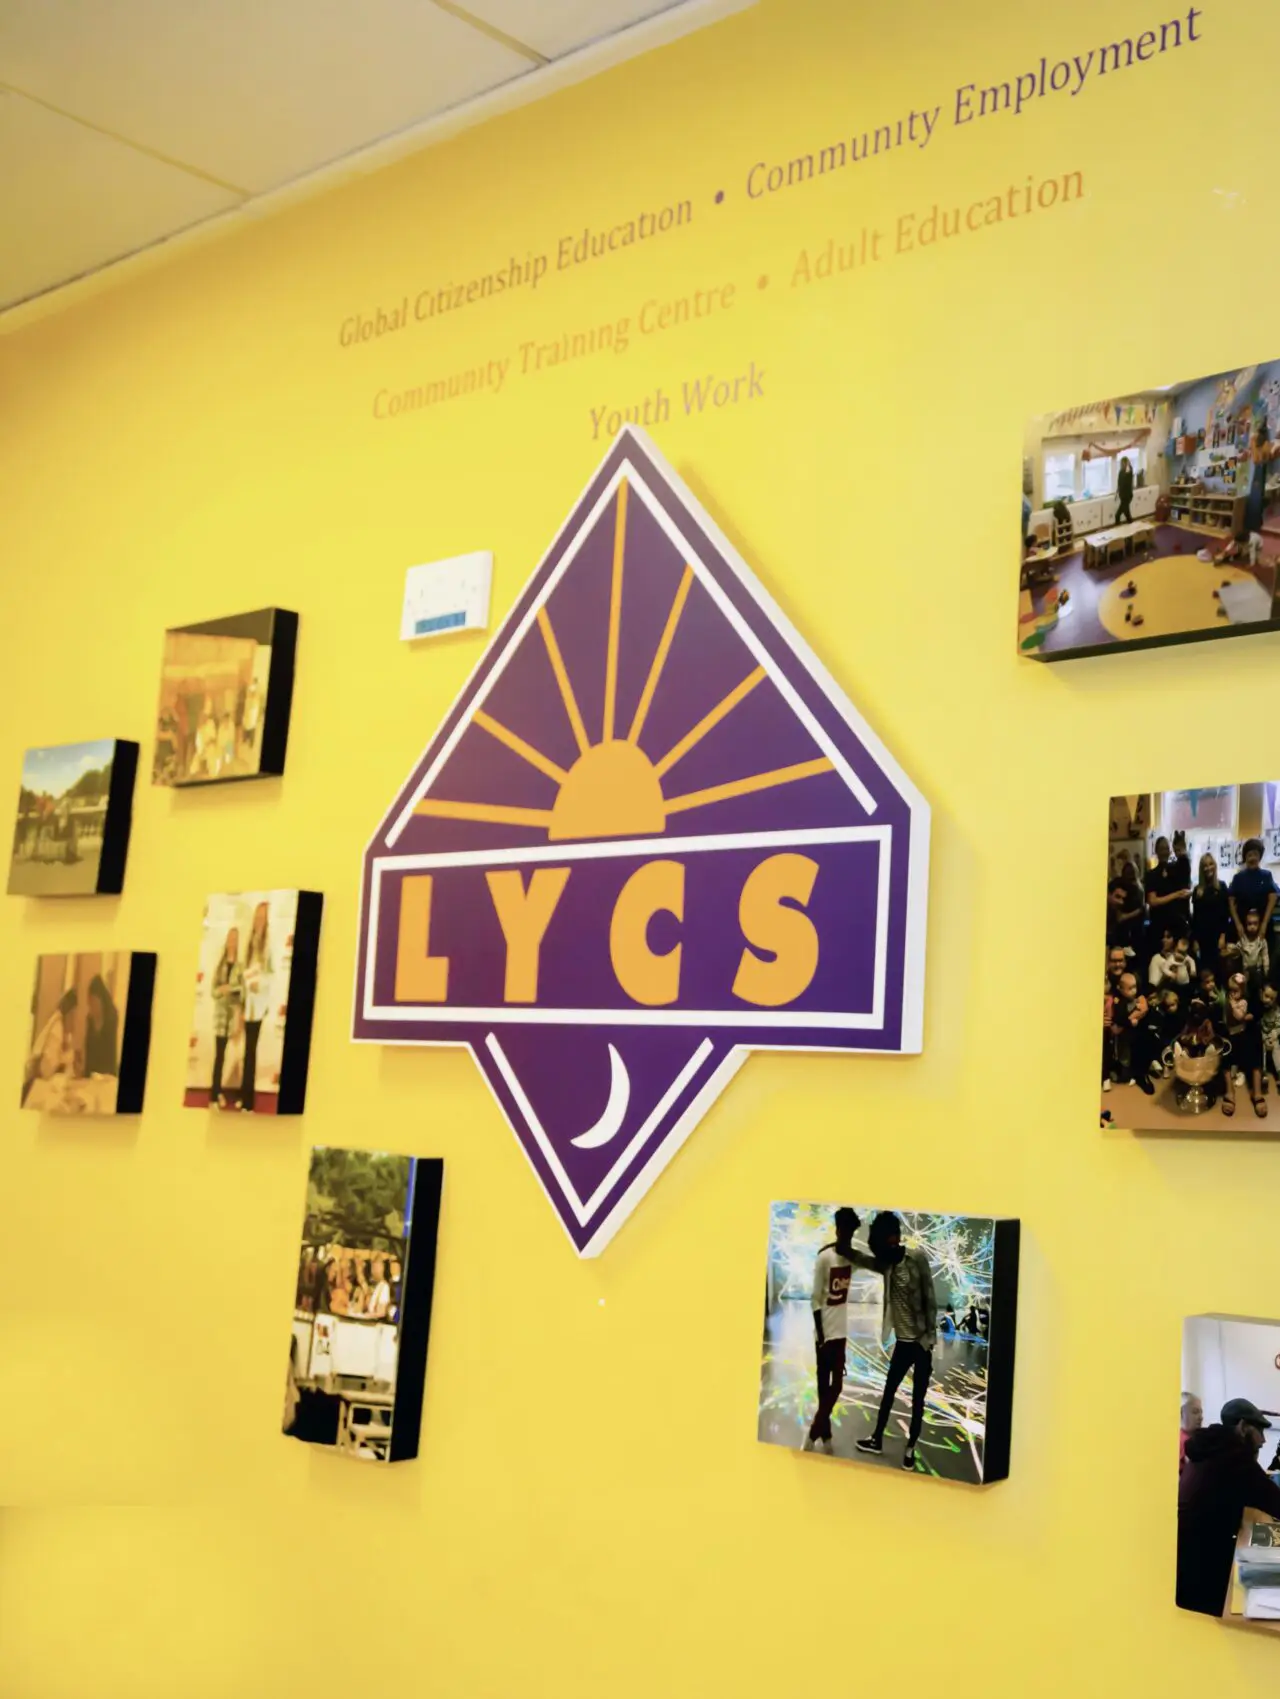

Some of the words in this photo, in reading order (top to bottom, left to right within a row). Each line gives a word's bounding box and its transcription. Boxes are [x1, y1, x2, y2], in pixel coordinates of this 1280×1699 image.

[339, 297, 409, 347] Global
[413, 251, 548, 322] Citizenship
[556, 199, 693, 272] Education
[746, 105, 941, 200] Community
[953, 6, 1203, 126] Employment
[371, 357, 511, 421] Community
[518, 316, 631, 374] Training
[637, 281, 737, 336] Centre
[789, 226, 886, 289] Adult
[894, 169, 1084, 255] Education
[588, 387, 671, 441] Youth
[681, 360, 766, 416] Work
[394, 853, 820, 1007] LYCS
